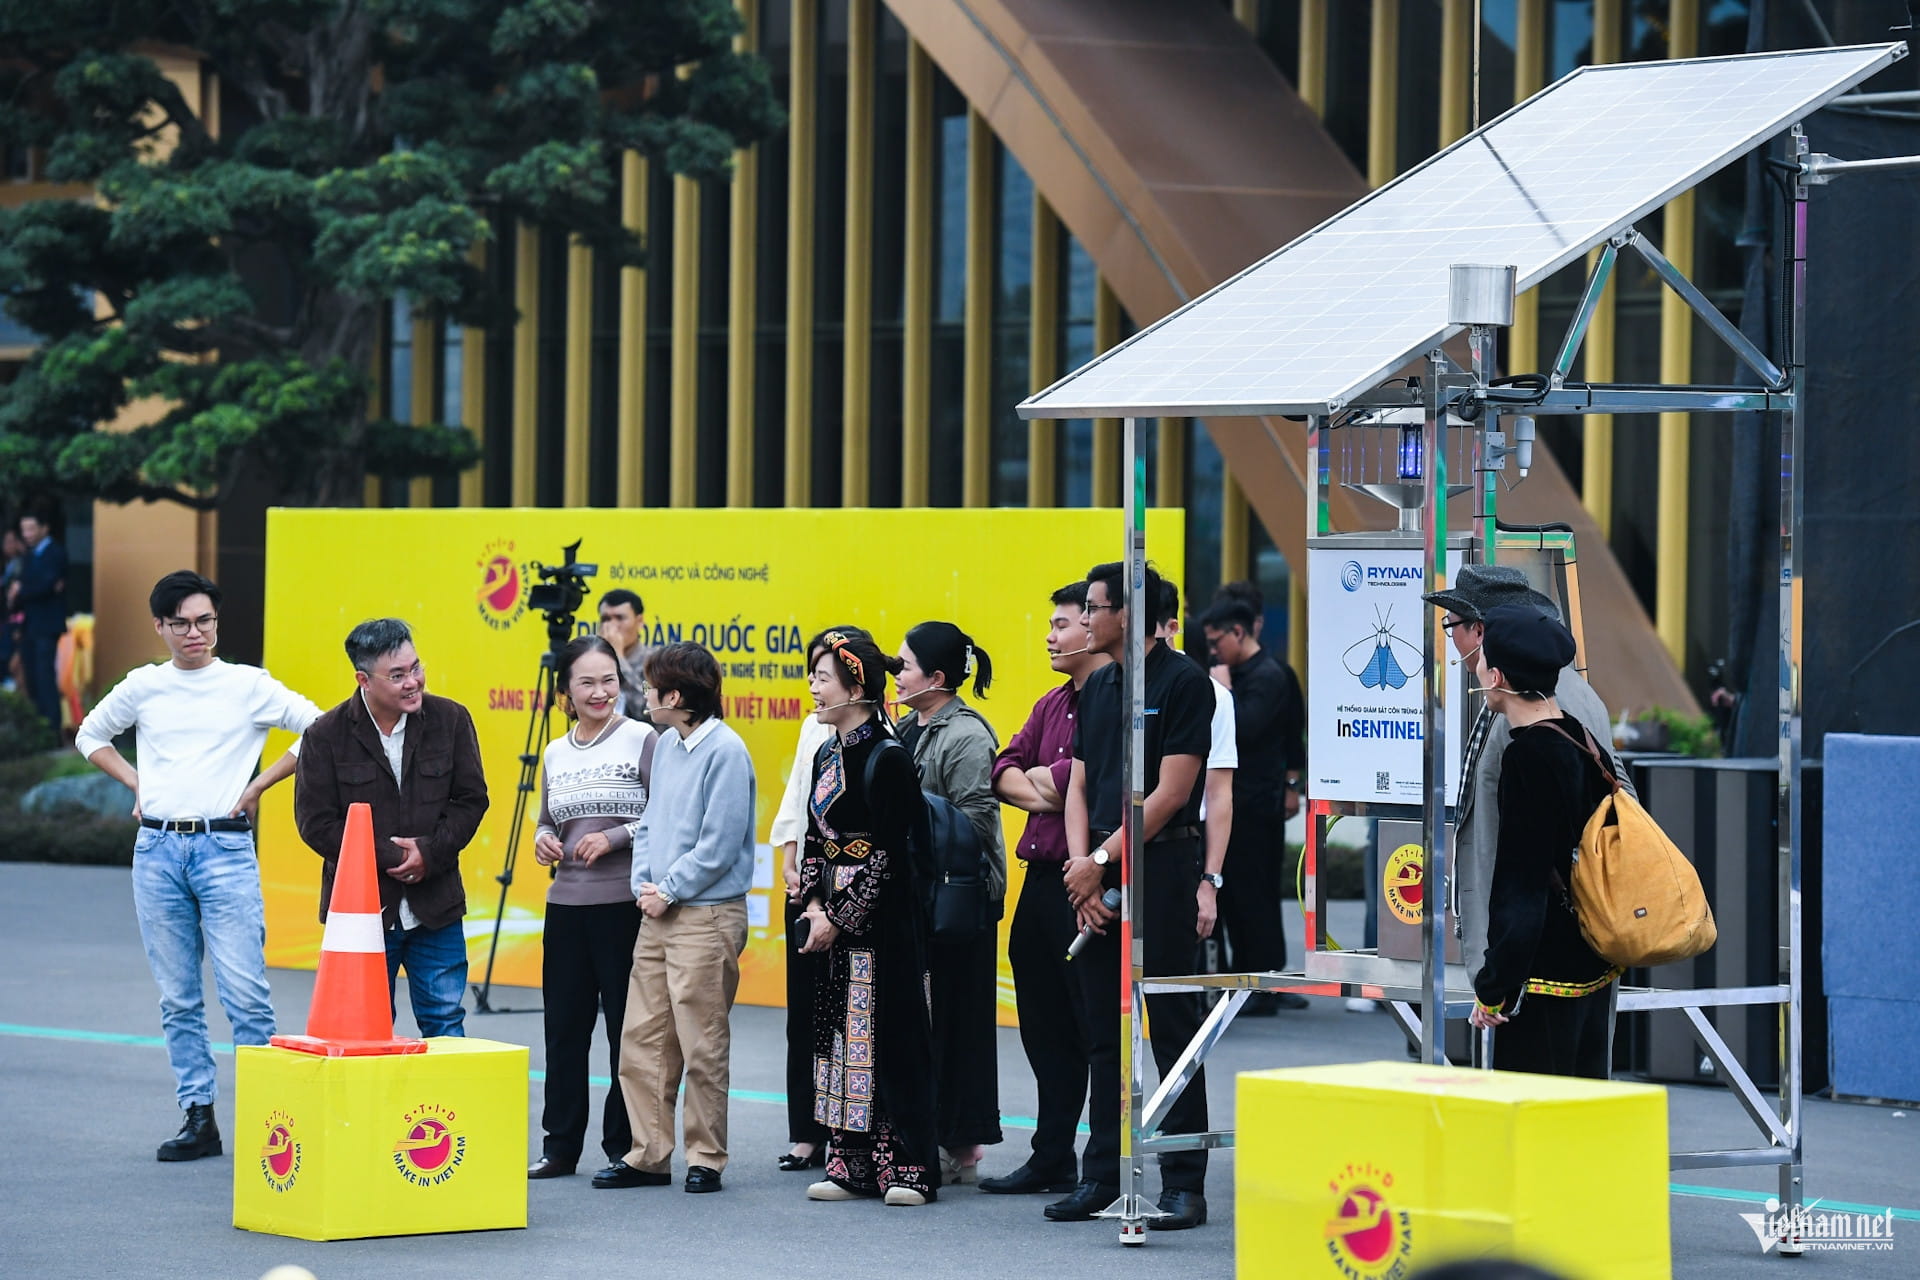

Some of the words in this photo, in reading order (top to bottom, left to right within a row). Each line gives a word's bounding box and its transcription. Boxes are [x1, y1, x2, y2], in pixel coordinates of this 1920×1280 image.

[610, 562, 624, 582] BỘ
[628, 566, 657, 579] KHOA
[661, 566, 684, 583] HỌC
[687, 561, 700, 579] VÀ
[704, 563, 735, 580] CÔNG
[738, 563, 769, 583] NGHỆ
[1367, 567, 1422, 579] RYNAN
[692, 614, 756, 653] QUỐC
[766, 625, 804, 654] GIA
[759, 661, 778, 682] VIỆT
[782, 664, 804, 679] NAM
[489, 682, 524, 711] SÁNG
[734, 691, 763, 726] VIỆT
[768, 697, 801, 720] NAM
[1337, 719, 1424, 740] InSENTINEL
[1389, 888, 1405, 914] MAKE
[1406, 909, 1414, 918] IN
[261, 1159, 275, 1189] MAKE
[276, 1184, 283, 1192] IN
[284, 1173, 296, 1191] VIET
[294, 1143, 302, 1173] NAM
[393, 1153, 417, 1183] MAKE
[418, 1177, 430, 1186] IN
[433, 1166, 455, 1185] VIET
[453, 1136, 466, 1166] NAM
